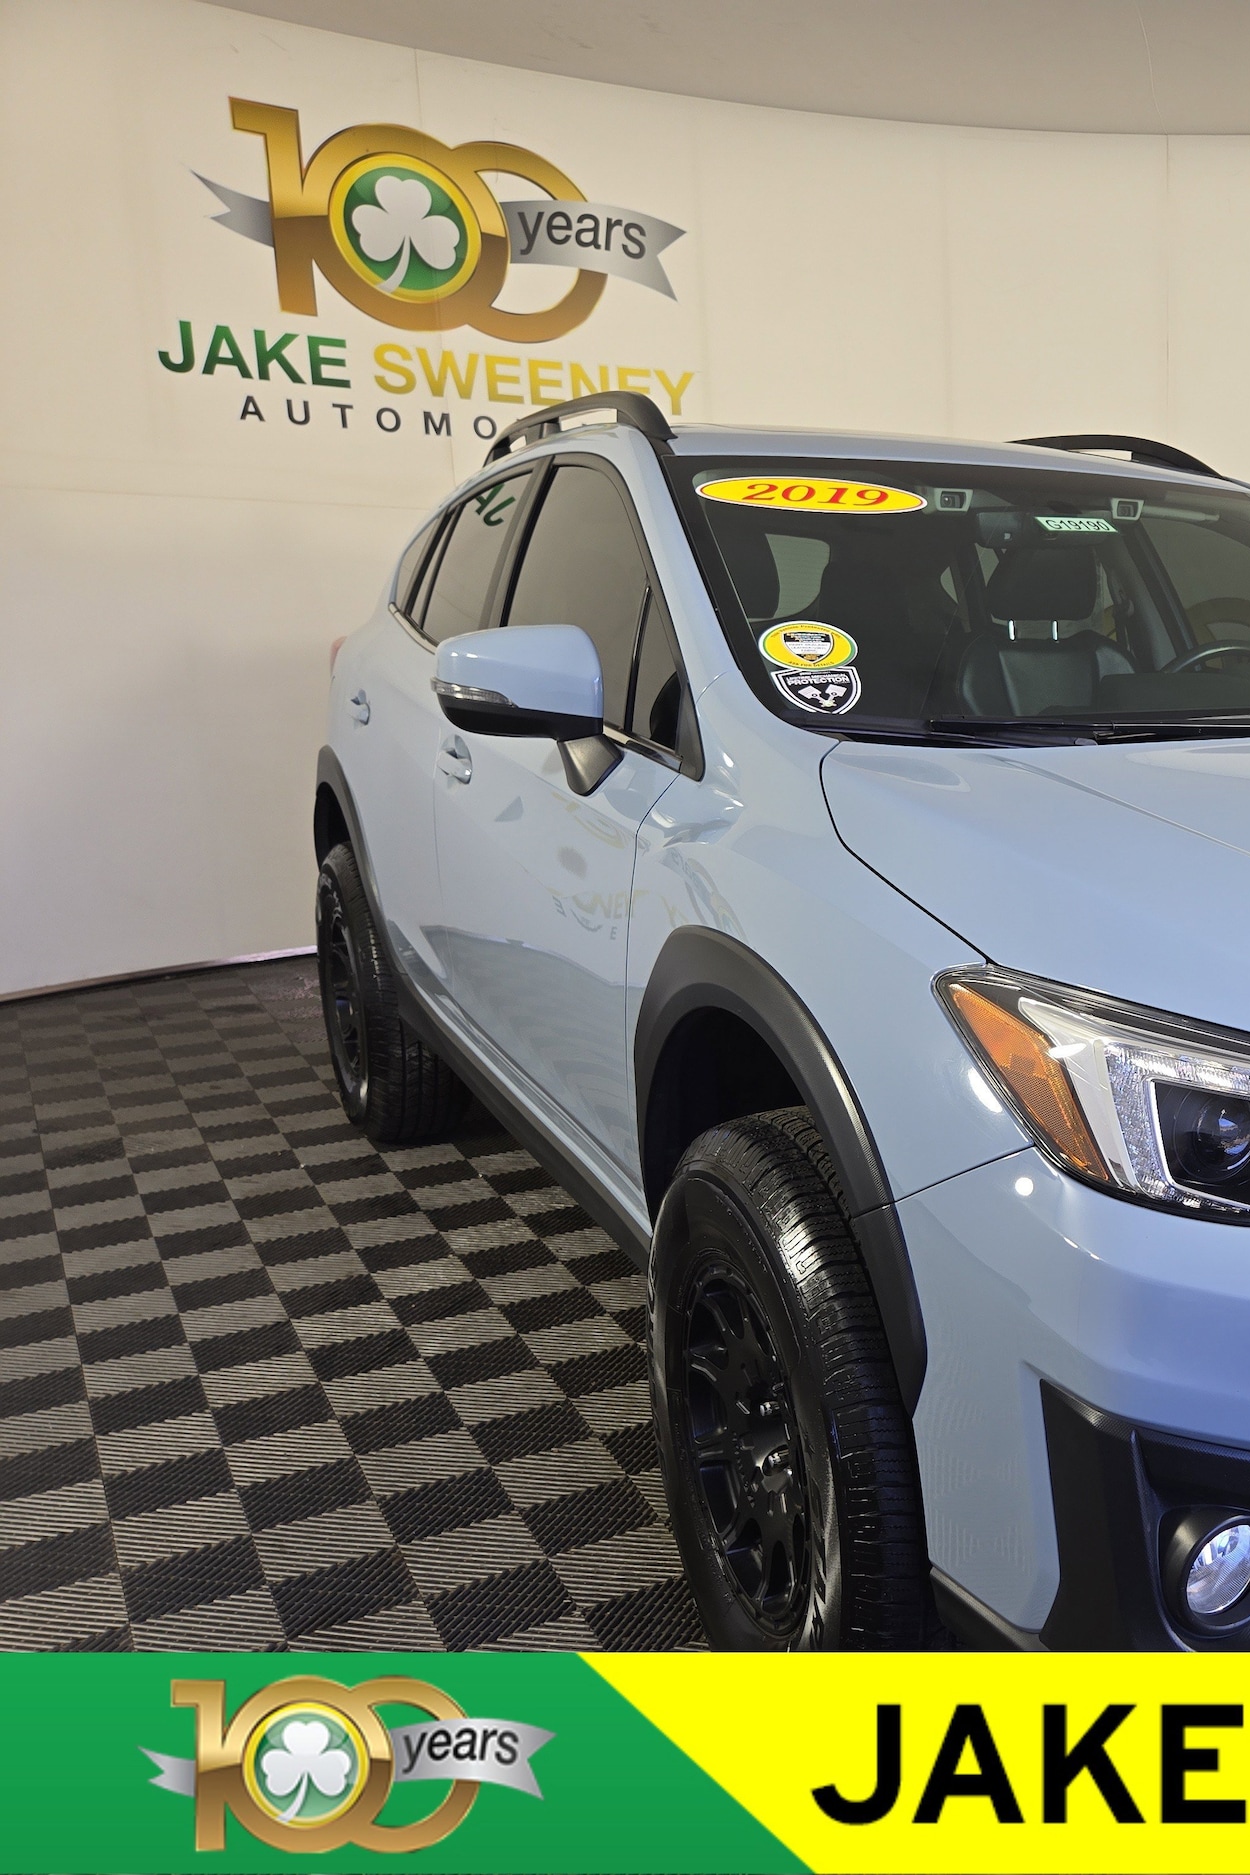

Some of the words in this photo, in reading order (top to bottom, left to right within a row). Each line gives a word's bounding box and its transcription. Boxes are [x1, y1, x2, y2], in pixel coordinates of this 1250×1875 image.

[517, 209, 648, 261] years
[157, 320, 352, 389] JAKE
[373, 343, 695, 416] SWEENEY
[741, 483, 890, 508] 2019
[1045, 519, 1111, 531] G19190
[786, 676, 851, 686] PROTECTION
